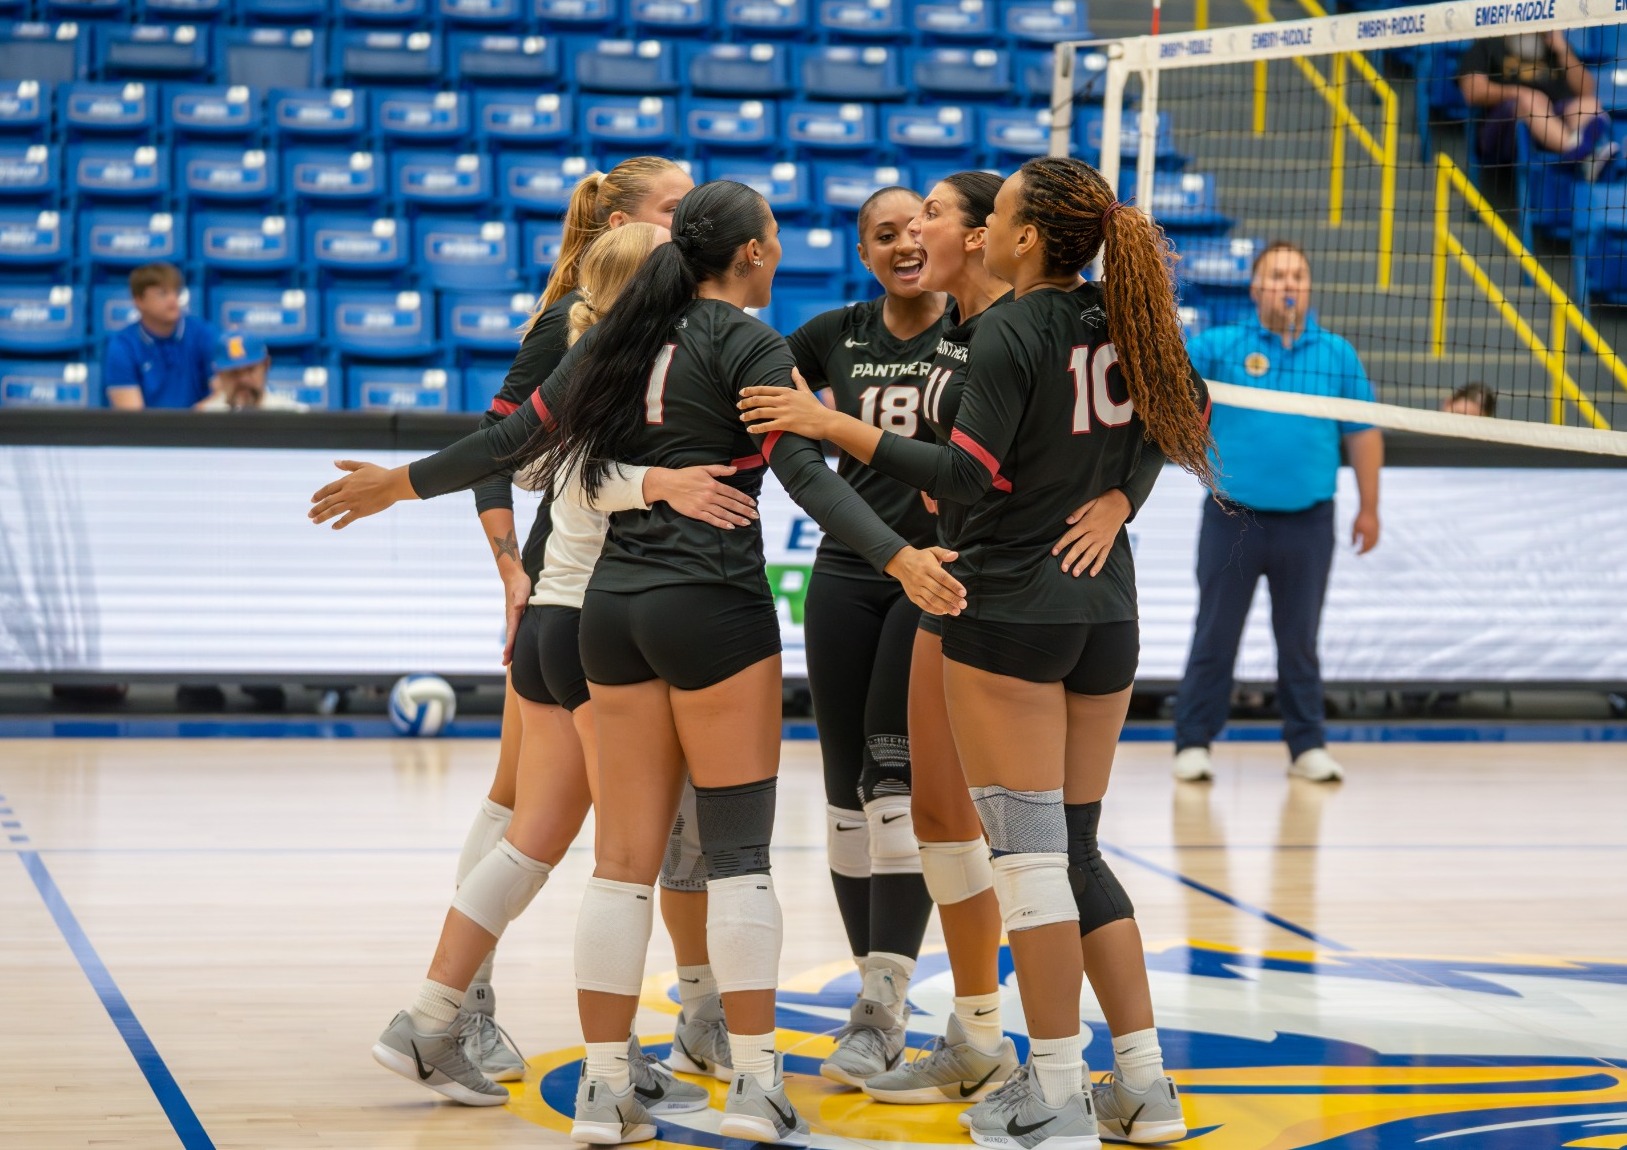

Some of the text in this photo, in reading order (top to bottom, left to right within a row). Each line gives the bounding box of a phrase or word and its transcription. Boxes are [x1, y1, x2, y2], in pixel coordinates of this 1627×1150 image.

[1357, 14, 1425, 39] EMBRY-RIDDLE
[1475, 0, 1556, 27] EMBRY-RIDDLE
[936, 337, 969, 363] ANTHER
[851, 361, 932, 378] PANTHER
[922, 366, 953, 424] 11
[1066, 340, 1135, 435] 10
[859, 385, 920, 438] 18
